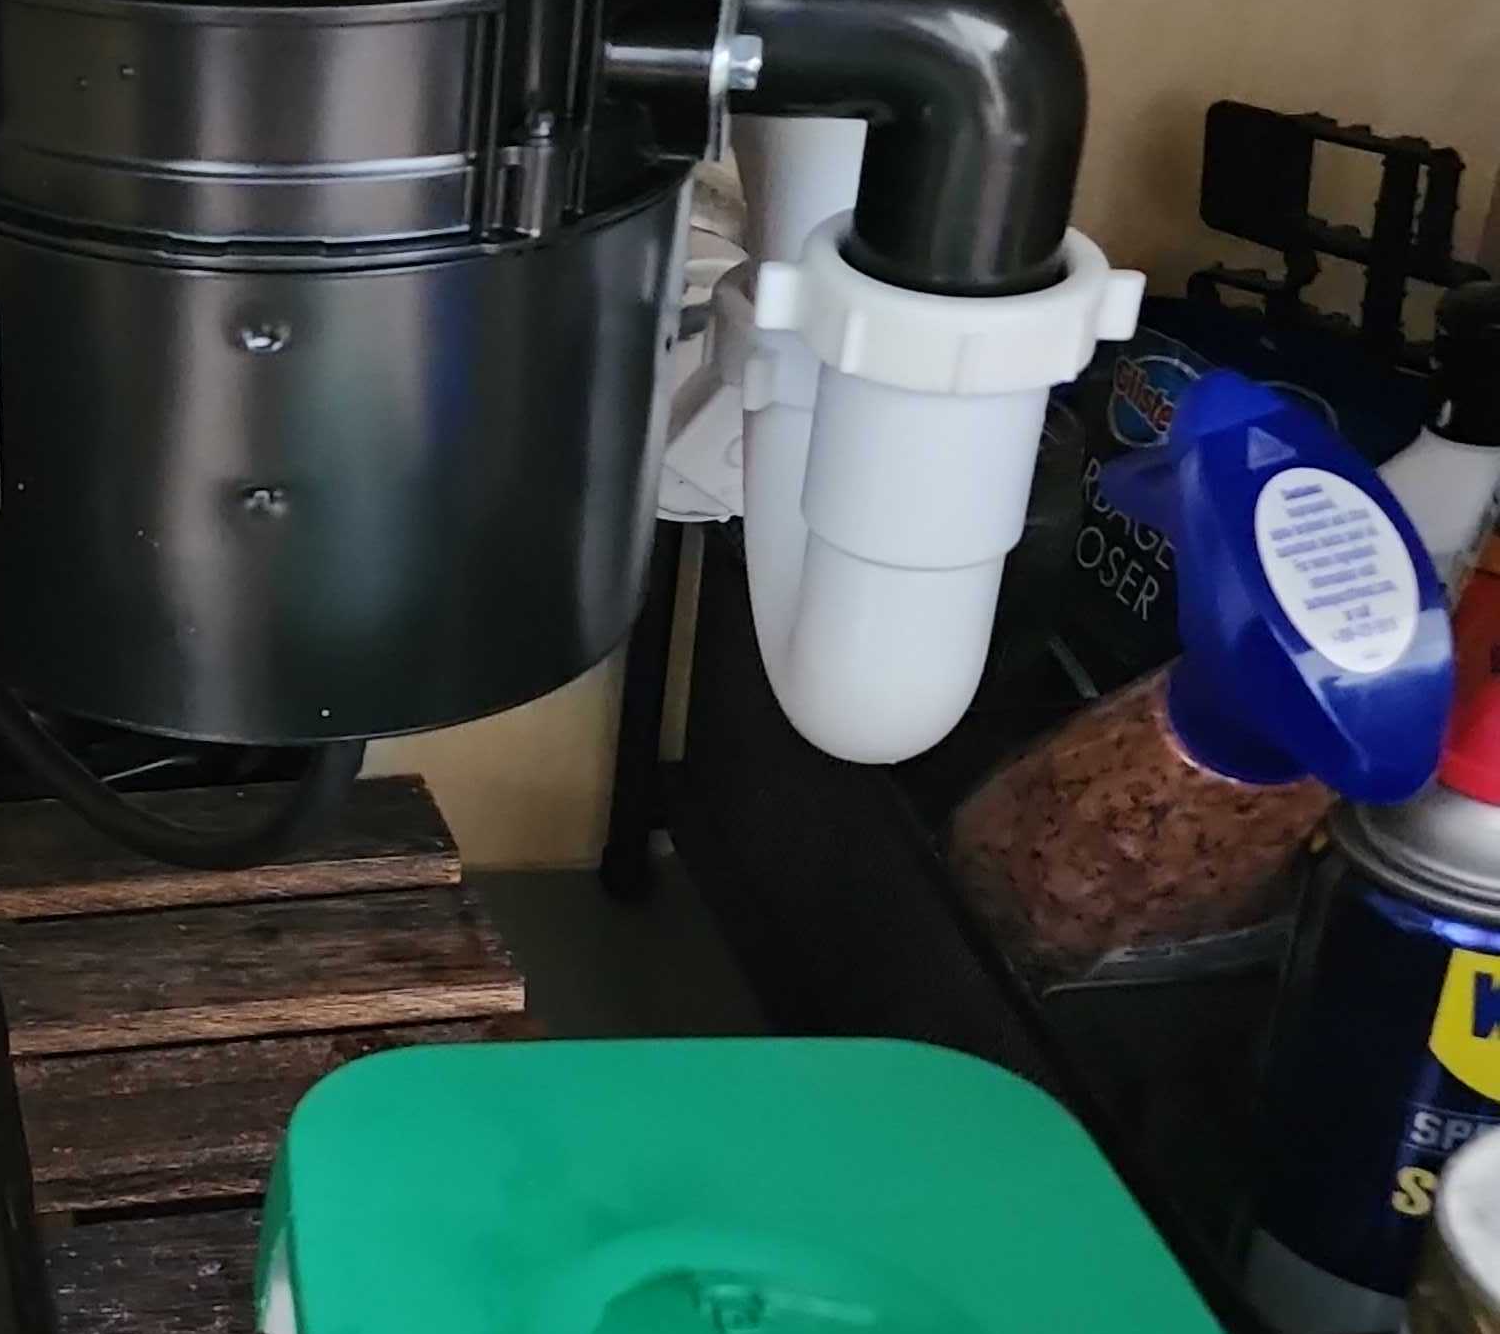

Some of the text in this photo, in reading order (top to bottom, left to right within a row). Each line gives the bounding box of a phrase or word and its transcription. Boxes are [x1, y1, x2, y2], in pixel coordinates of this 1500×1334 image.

[1113, 355, 1176, 436] Gliste
[1076, 526, 1160, 621] OSER
[1410, 1110, 1492, 1152] SP
